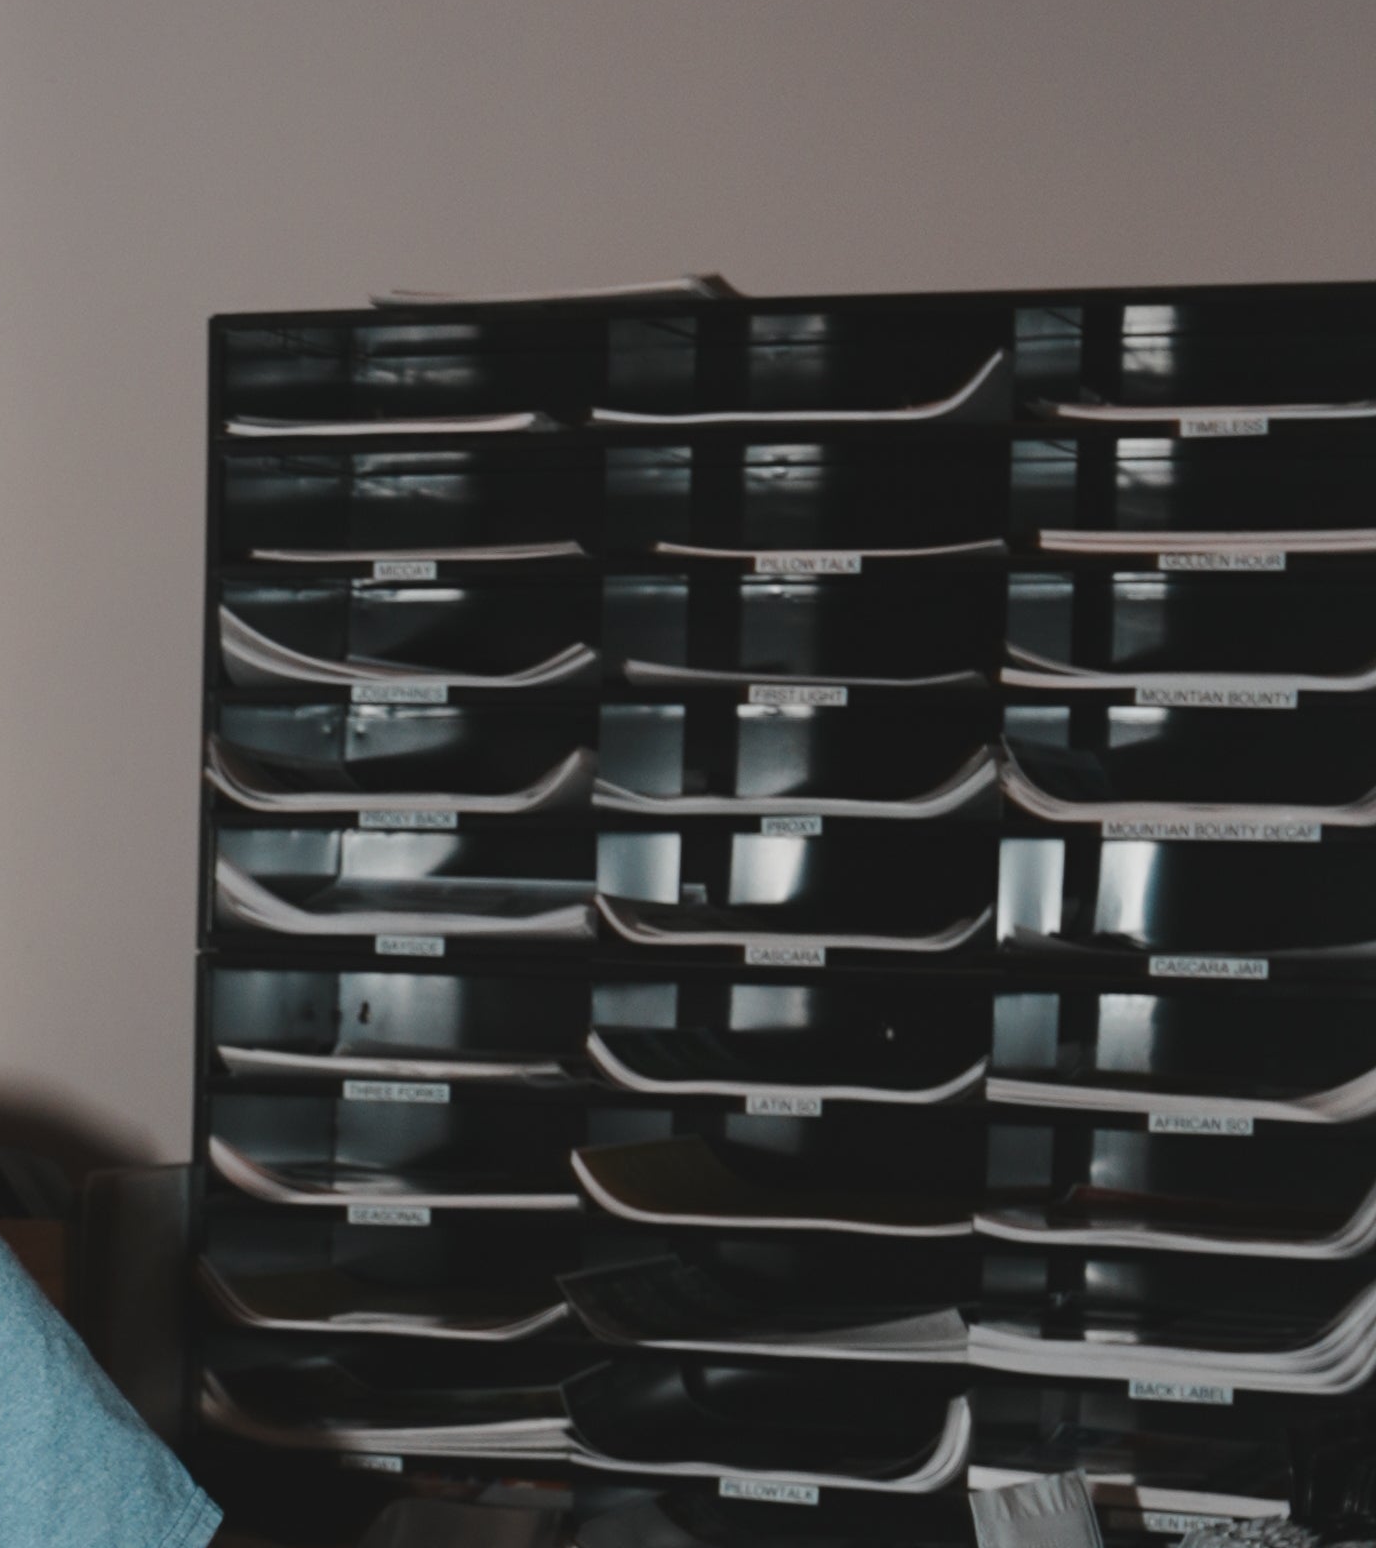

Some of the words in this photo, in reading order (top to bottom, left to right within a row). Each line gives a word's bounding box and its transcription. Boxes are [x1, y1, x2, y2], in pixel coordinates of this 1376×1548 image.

[1187, 419, 1263, 434] TIMELESS
[761, 557, 815, 570] PILLOW
[821, 557, 856, 570] TALK
[1165, 554, 1230, 567] GOLDEN
[1233, 554, 1281, 568] HOUR
[753, 687, 794, 702] FIRST
[799, 688, 843, 703] LIGHT
[1227, 691, 1291, 706] BOUNTY
[365, 812, 413, 826] PROXY
[416, 813, 452, 826] BACK
[767, 820, 816, 833] PROXY
[1194, 824, 1258, 838] BOUNTY
[1262, 825, 1315, 839] DECAF
[749, 949, 820, 964] CASCARA
[1154, 959, 1229, 974] CASCARA
[1233, 961, 1264, 976] JAR
[350, 1083, 393, 1097] THREE
[751, 1098, 791, 1111] LATIN
[1154, 1115, 1222, 1130] AFRICAN
[353, 1208, 425, 1222] SEASONAL
[1134, 1383, 1174, 1397] BACK
[1180, 1384, 1228, 1400] LABEL
